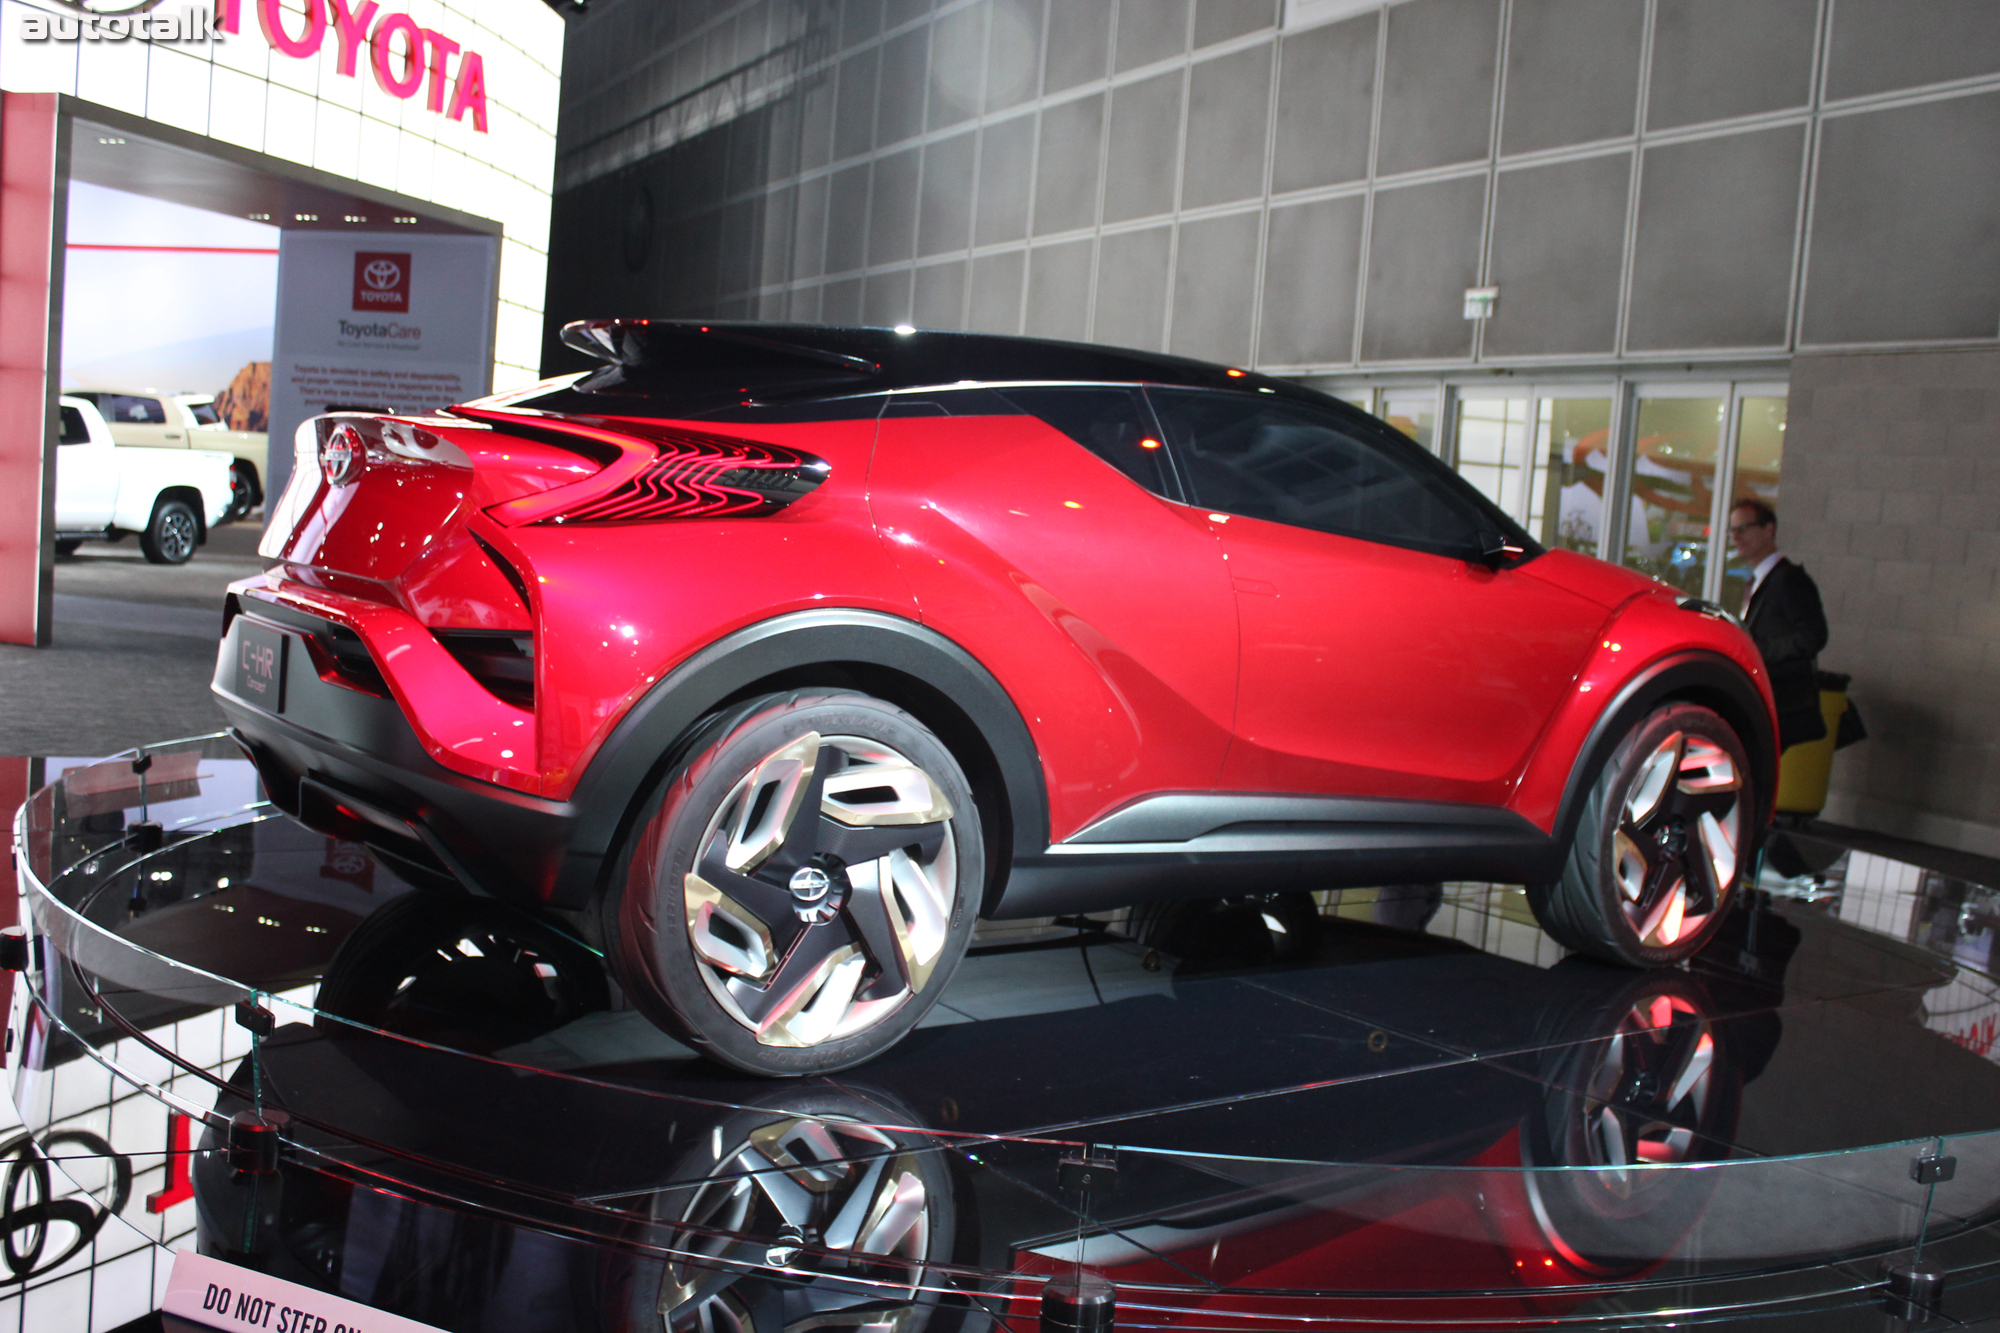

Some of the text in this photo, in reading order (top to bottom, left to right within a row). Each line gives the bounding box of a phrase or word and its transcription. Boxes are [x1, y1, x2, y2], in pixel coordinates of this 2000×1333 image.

[361, 291, 403, 303] TOYOTA
[338, 319, 421, 340] ToyotaCare
[242, 640, 274, 680] C-HR
[203, 1283, 232, 1315] DO
[234, 1292, 276, 1328] NOT
